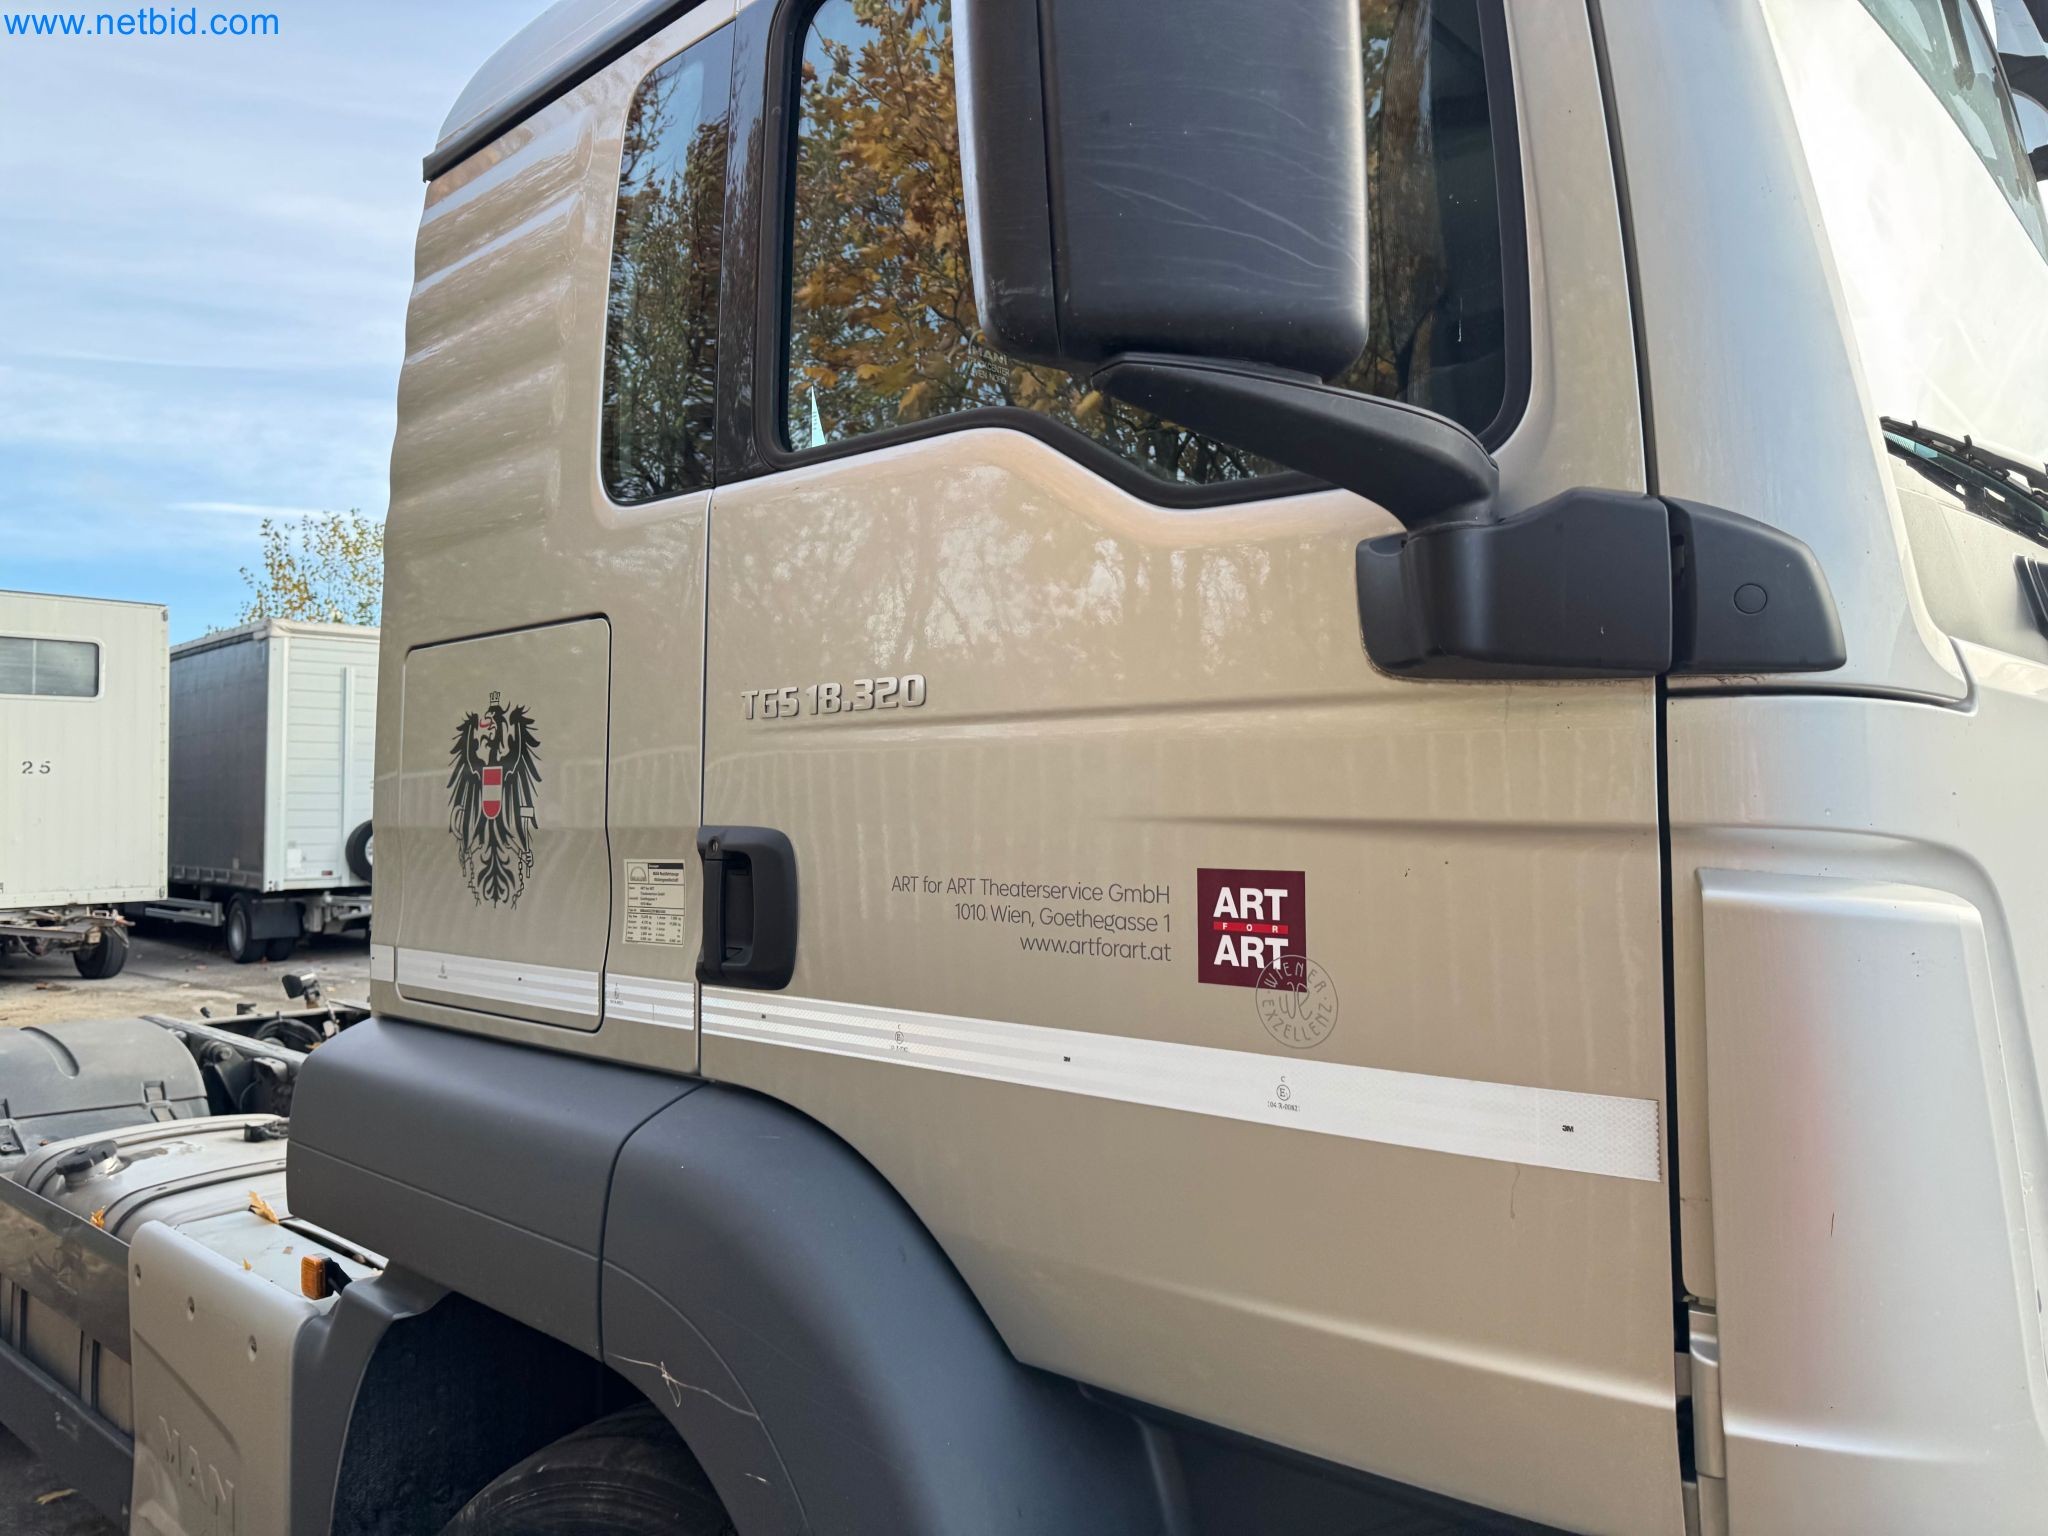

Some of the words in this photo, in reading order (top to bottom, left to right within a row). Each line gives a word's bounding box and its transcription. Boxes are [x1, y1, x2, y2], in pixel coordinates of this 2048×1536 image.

[740, 686, 800, 720] TGS
[804, 673, 927, 716] 18.320
[891, 875, 919, 893] ART
[922, 876, 943, 894] for
[946, 877, 975, 895] ART
[980, 878, 1103, 901] Theaterservice
[1108, 883, 1171, 904] GmbH
[1212, 886, 1289, 921] ART
[955, 903, 986, 922] 1010
[990, 904, 1035, 928] Wien,
[1039, 907, 1158, 933] Goethegasse
[1163, 914, 1171, 932] 1
[1222, 922, 1279, 933] FOR
[1020, 936, 1172, 962] www.artforart.at
[1213, 934, 1289, 970] ART
[1263, 961, 1328, 993] WIENER
[1262, 998, 1332, 1043] EXZELLENZ
[1562, 1124, 1574, 1133] 3M
